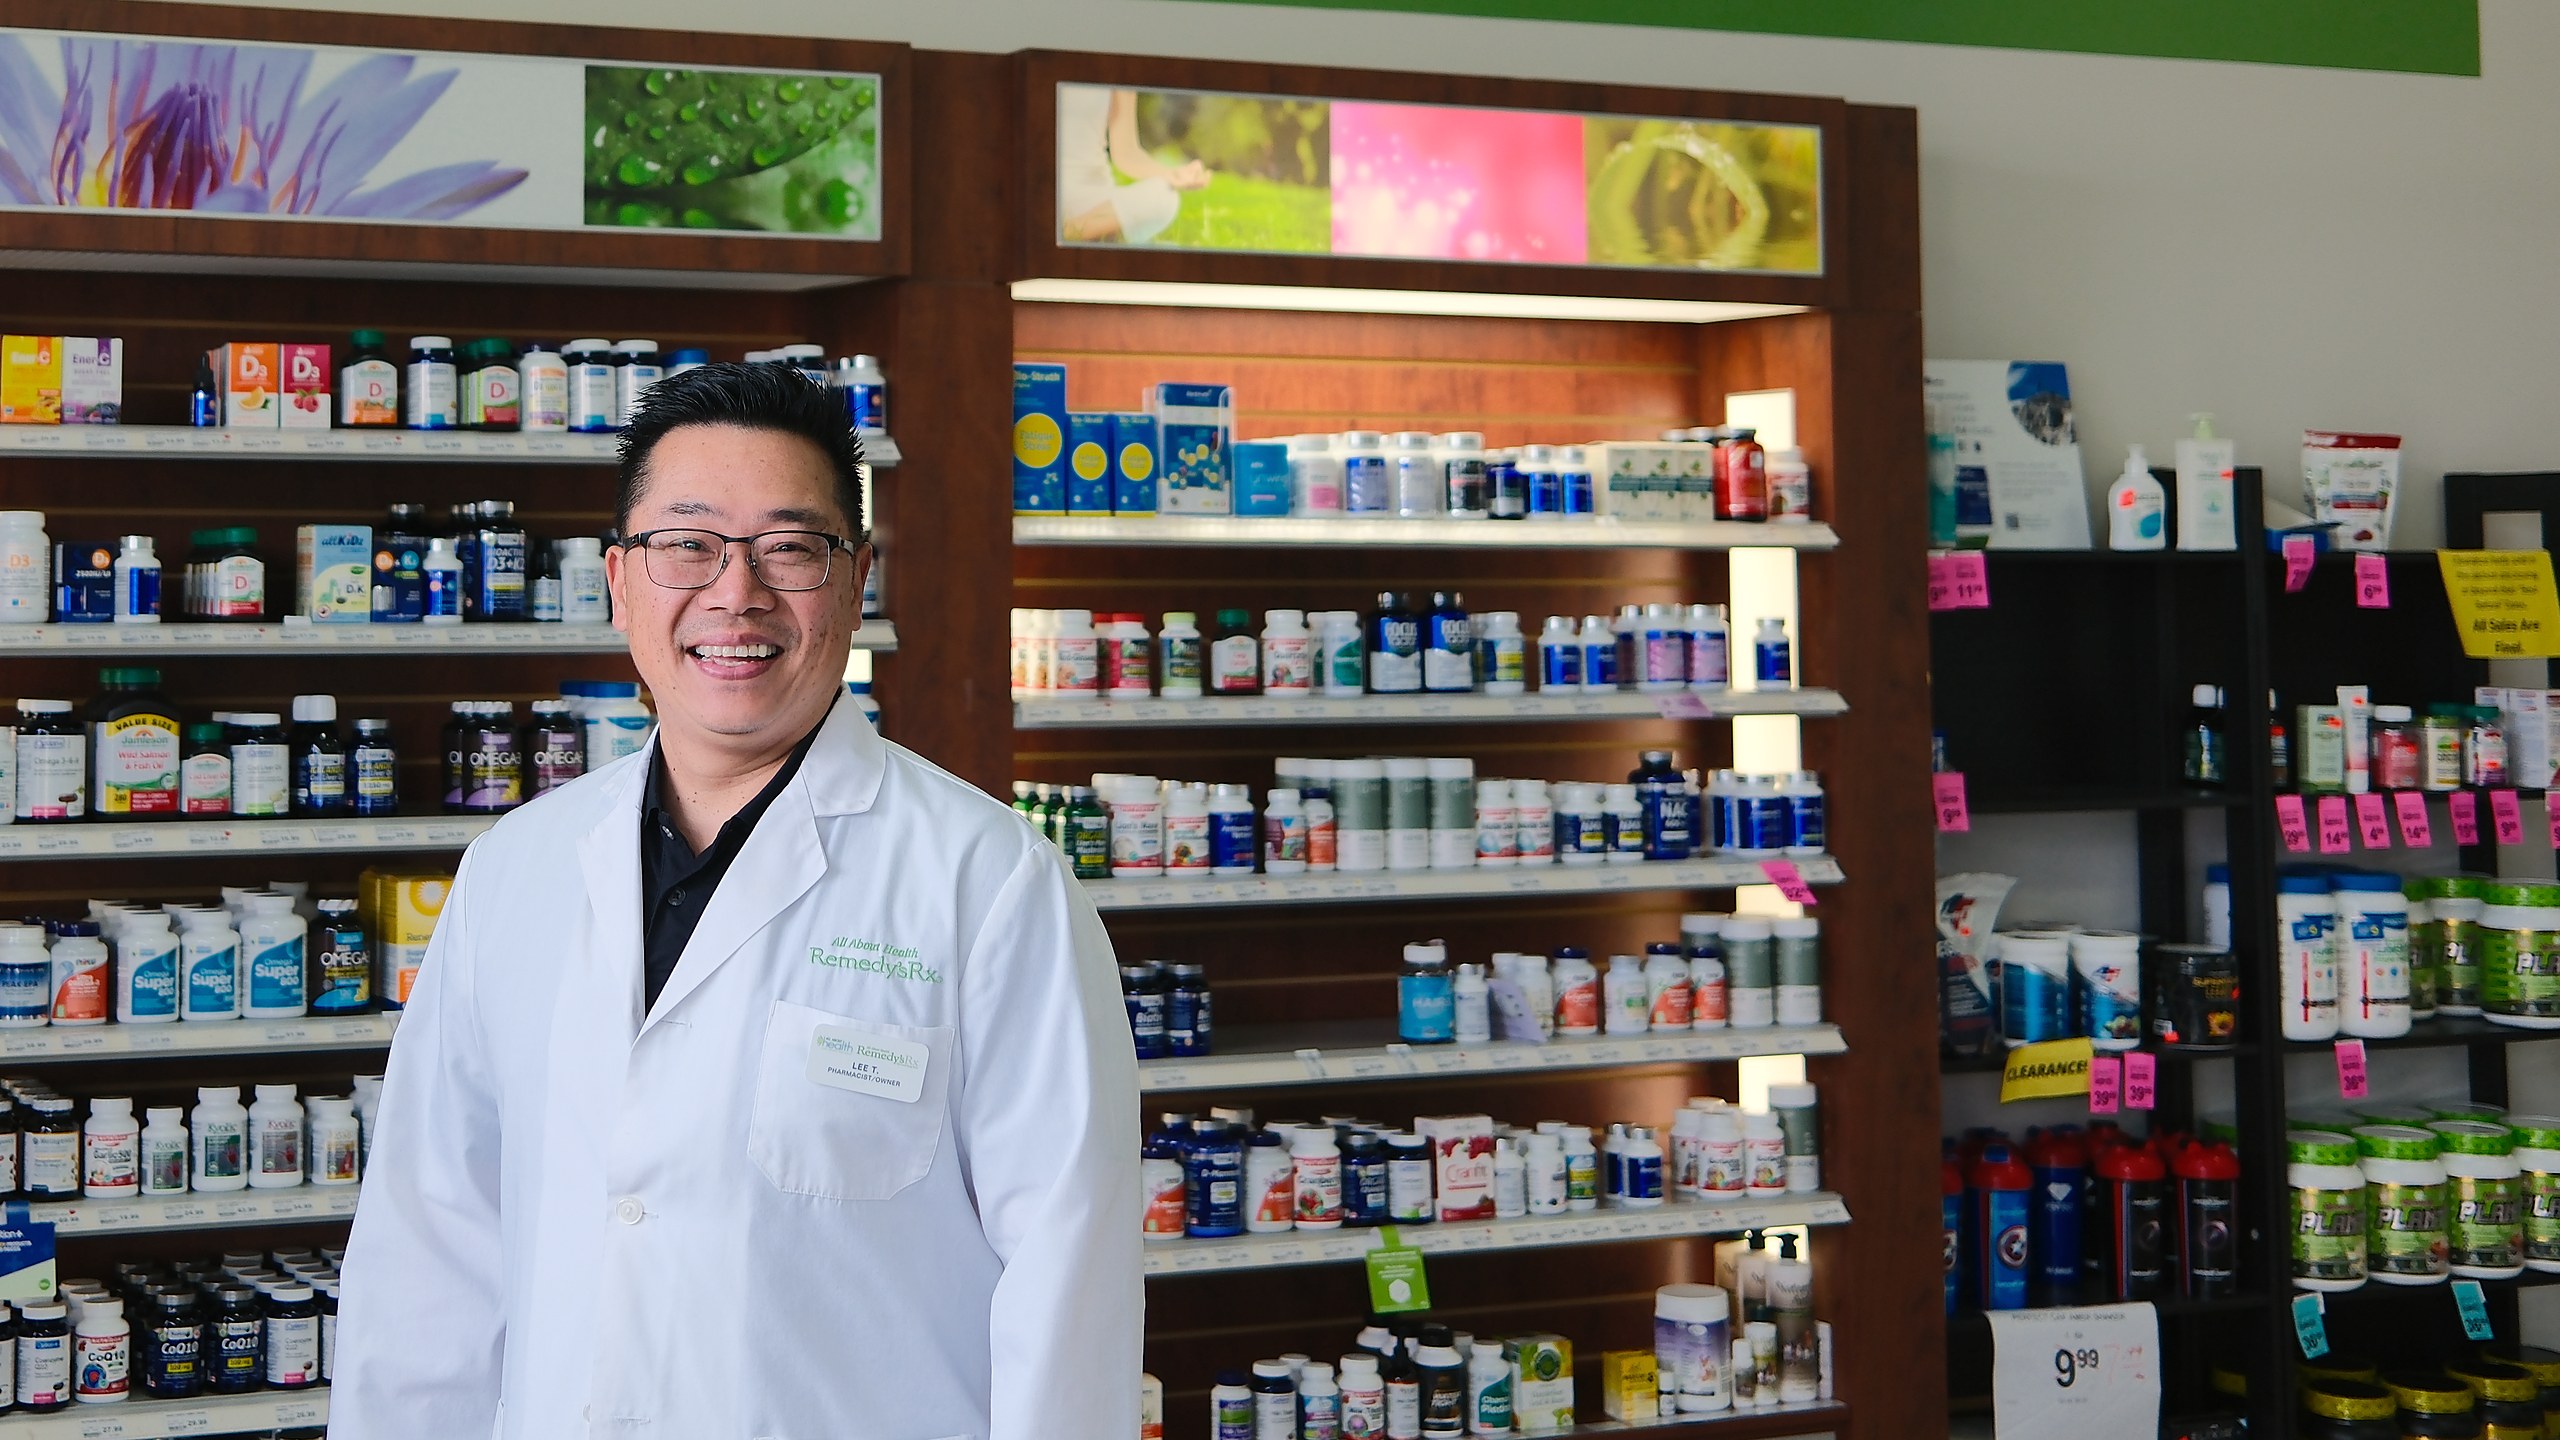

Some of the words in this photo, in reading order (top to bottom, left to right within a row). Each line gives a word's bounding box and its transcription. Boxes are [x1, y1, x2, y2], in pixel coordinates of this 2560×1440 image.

[115, 717, 147, 731] VALUE
[152, 718, 173, 731] SIZE
[831, 936, 848, 948] All
[848, 938, 881, 952] About
[881, 943, 919, 959] Health
[254, 964, 300, 978] Super
[134, 976, 175, 990] Super
[191, 974, 232, 987] Super
[852, 1061, 869, 1073] LEE
[871, 1066, 880, 1075] T.
[2006, 1059, 2088, 1082] CLEARANCE!
[827, 1066, 902, 1088] PHARMACIST/OWNER
[161, 1341, 200, 1355] CoQ10
[221, 1336, 259, 1350] CoQ10
[88, 1352, 126, 1362] CoQ10
